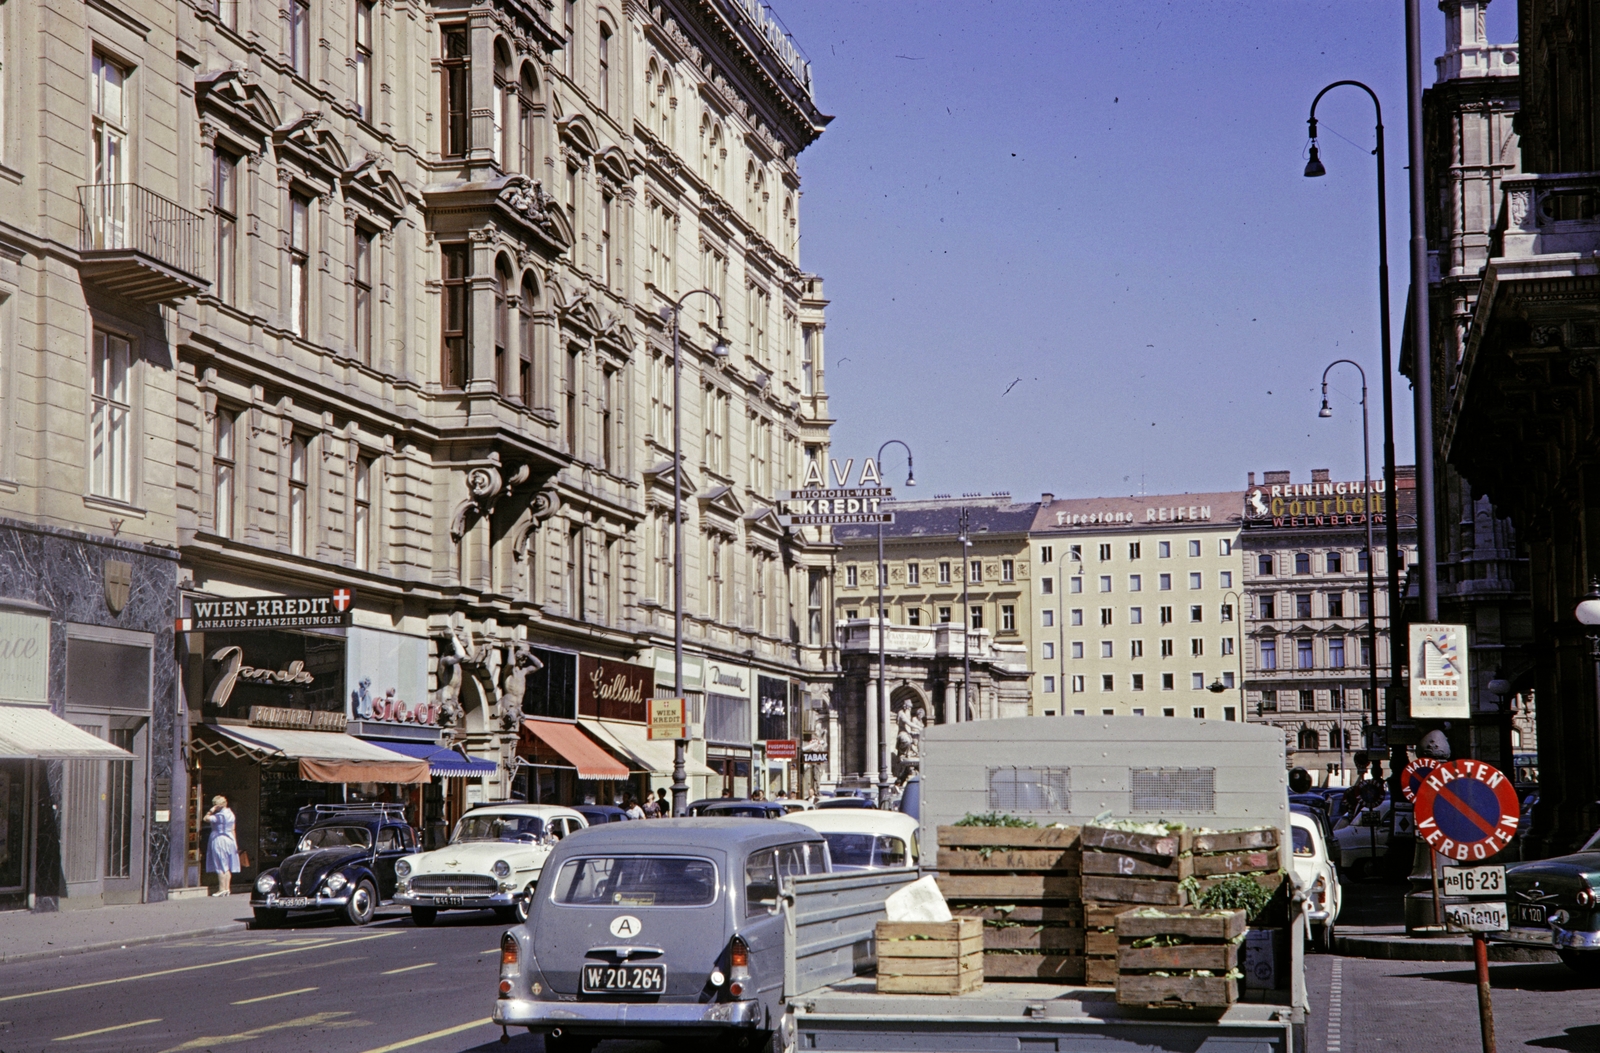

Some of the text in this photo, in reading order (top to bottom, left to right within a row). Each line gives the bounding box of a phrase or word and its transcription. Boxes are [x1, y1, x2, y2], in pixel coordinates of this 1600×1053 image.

[803, 458, 881, 487] AVA
[803, 498, 880, 515] KREDIT
[1055, 505, 1211, 526] Firestone REIFEN
[798, 514, 885, 524] VERKEHRSANSTALT
[1272, 514, 1399, 527] WEINBRAN
[194, 598, 330, 618] WIEN-KREDIT
[196, 615, 342, 629] ANKAUFSFINANZIERUNGEN
[803, 753, 828, 762] TABAK
[1426, 761, 1504, 792] HALTEN
[1418, 814, 1519, 861] VERBOTEN
[1118, 856, 1136, 875] 12
[1446, 871, 1499, 890] AB 16-23
[617, 918, 633, 935] A
[1453, 907, 1501, 927] Anfang
[588, 968, 662, 989] W 20.264
